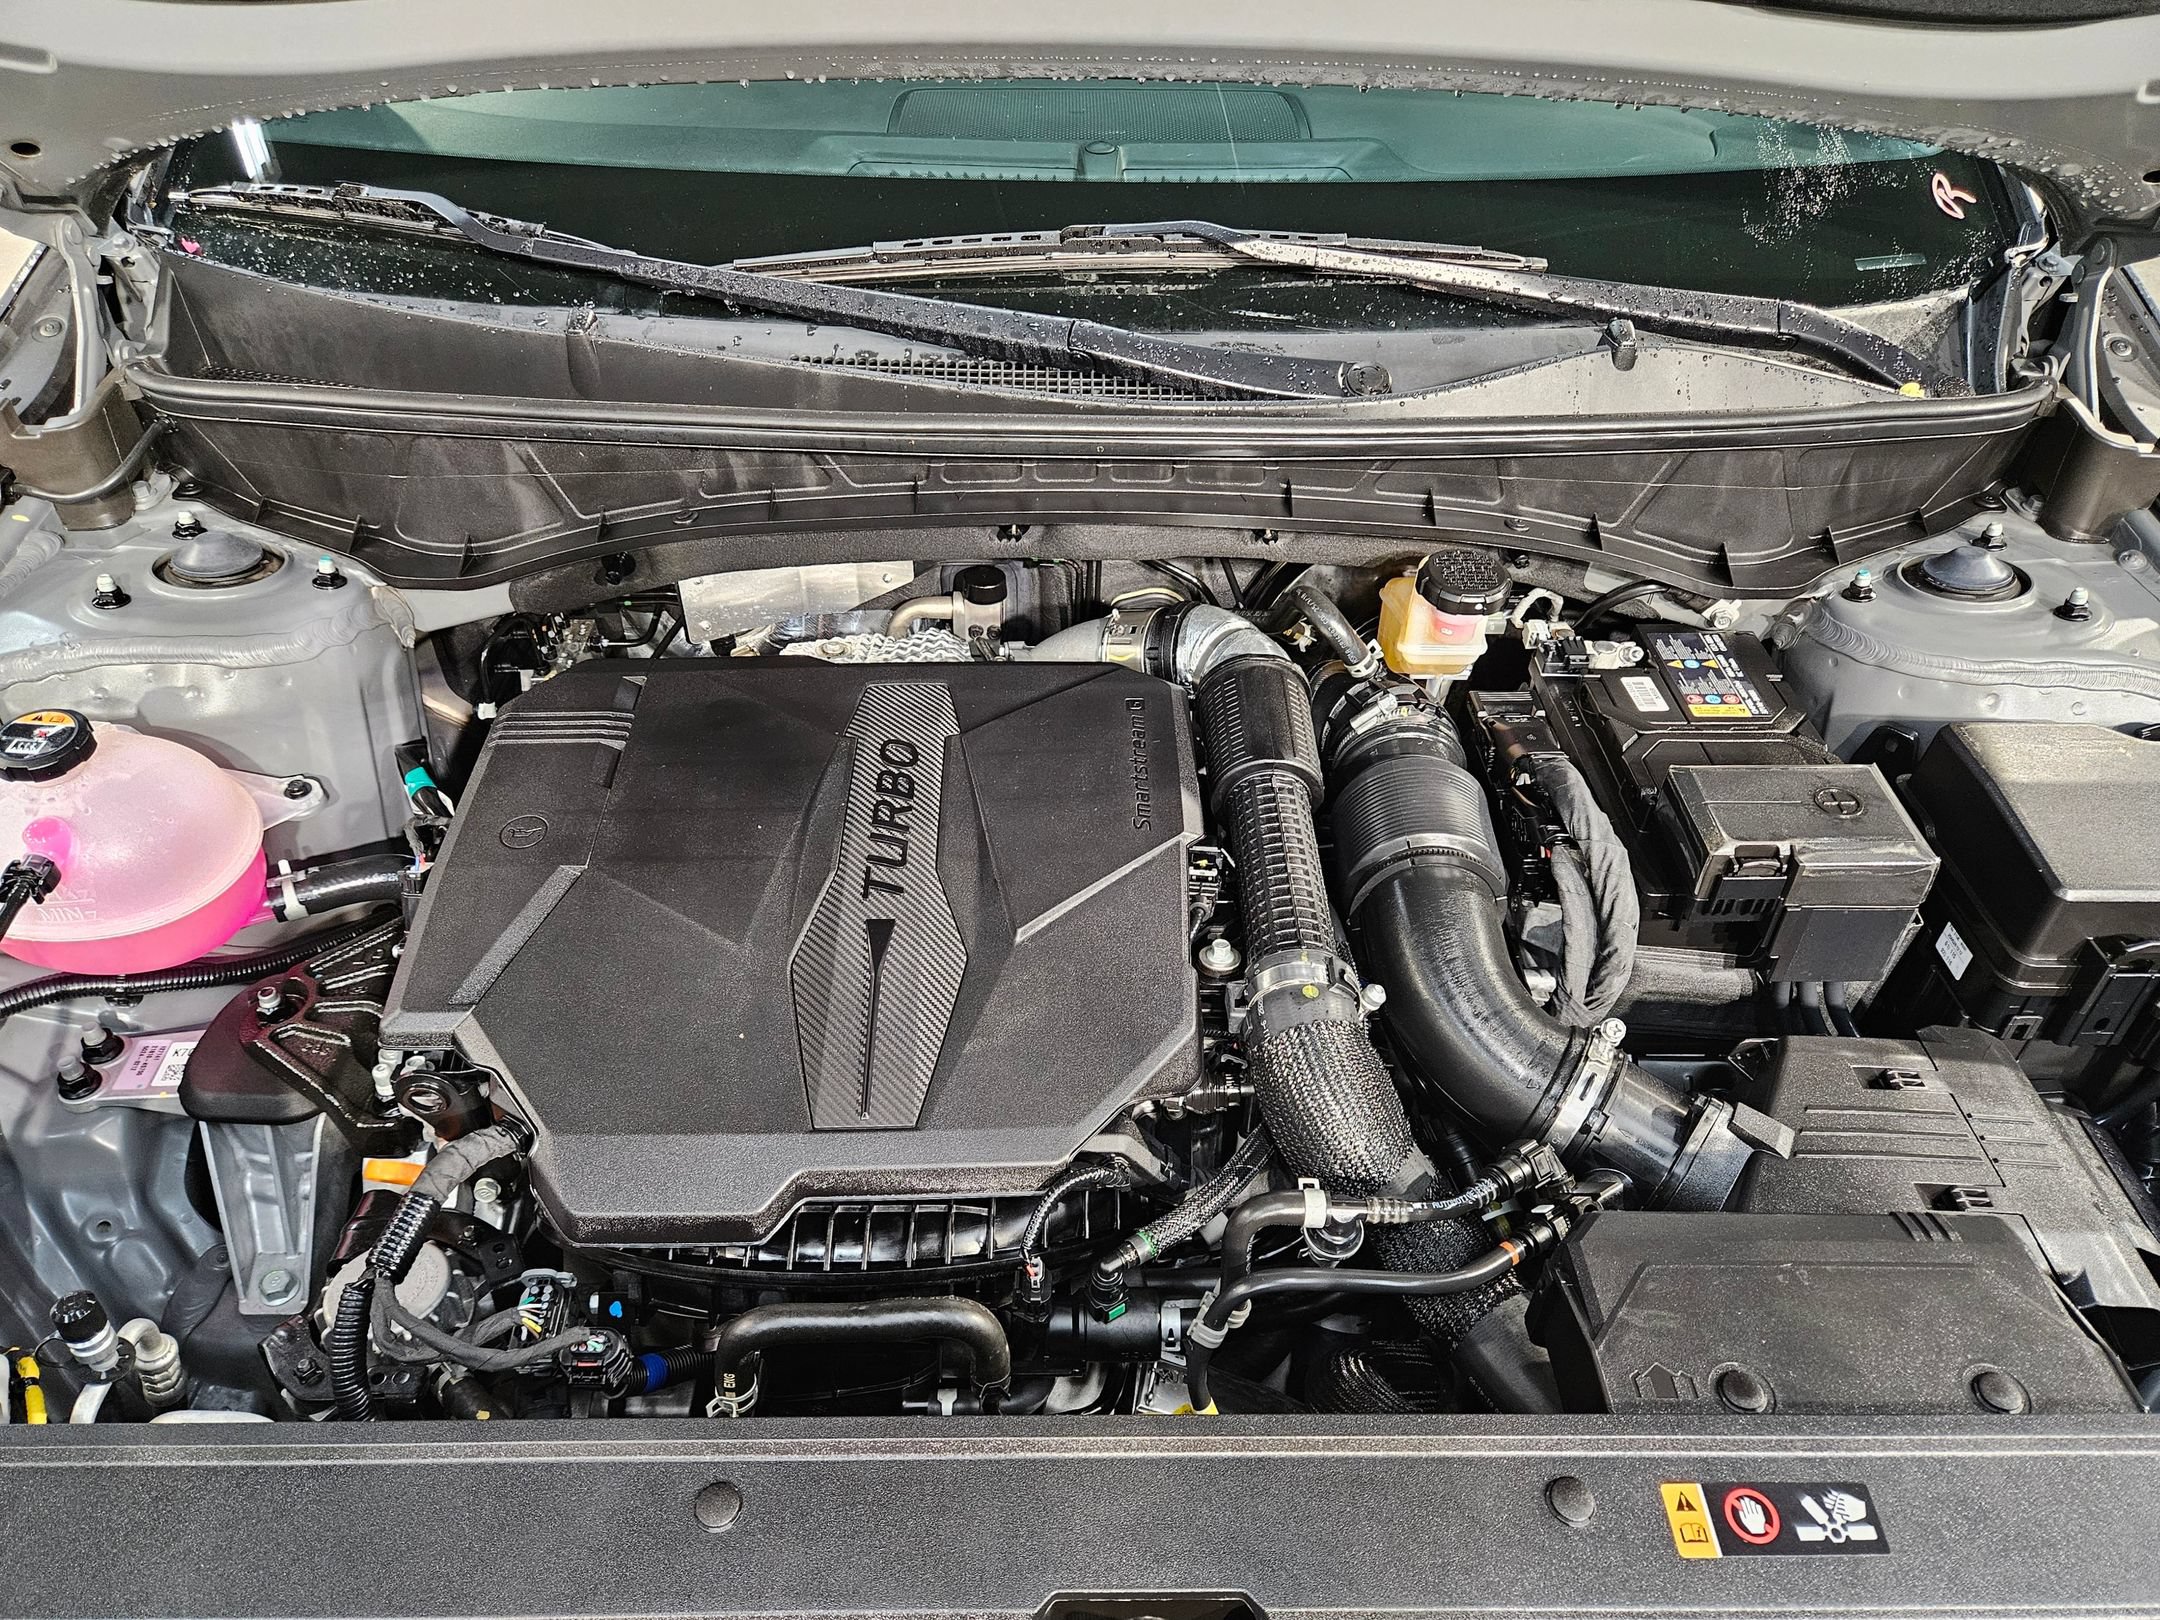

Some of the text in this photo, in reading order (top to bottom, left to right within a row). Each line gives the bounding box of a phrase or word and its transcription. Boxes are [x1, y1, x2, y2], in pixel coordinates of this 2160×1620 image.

[862, 739, 919, 898] TURBO
[1129, 714, 1152, 831] Smartstream
[723, 1373, 736, 1388] ENG
